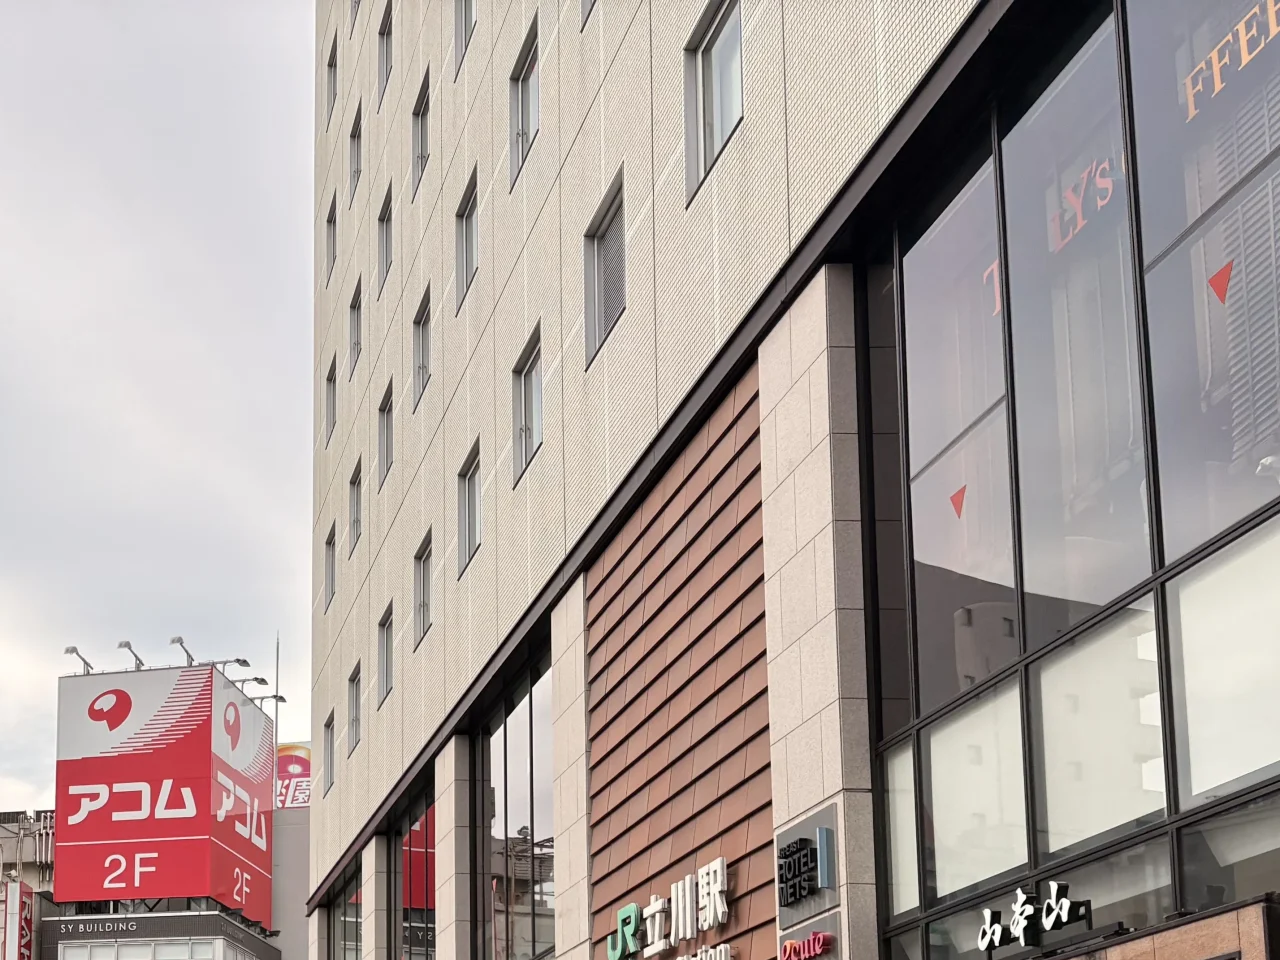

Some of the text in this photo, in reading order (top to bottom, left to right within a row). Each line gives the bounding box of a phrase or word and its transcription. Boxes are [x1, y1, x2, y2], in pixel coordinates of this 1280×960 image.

[1183, 0, 1280, 123] FFEE
[67, 779, 197, 826] アコム
[216, 770, 267, 852] アコム
[103, 852, 159, 889] 2F
[233, 867, 252, 905] 2F
[778, 848, 816, 883] HOTEL
[643, 856, 730, 959] 立川駅
[779, 875, 811, 907] METS
[60, 921, 137, 933] SY BUILDING
[978, 880, 1071, 951] 山本山
